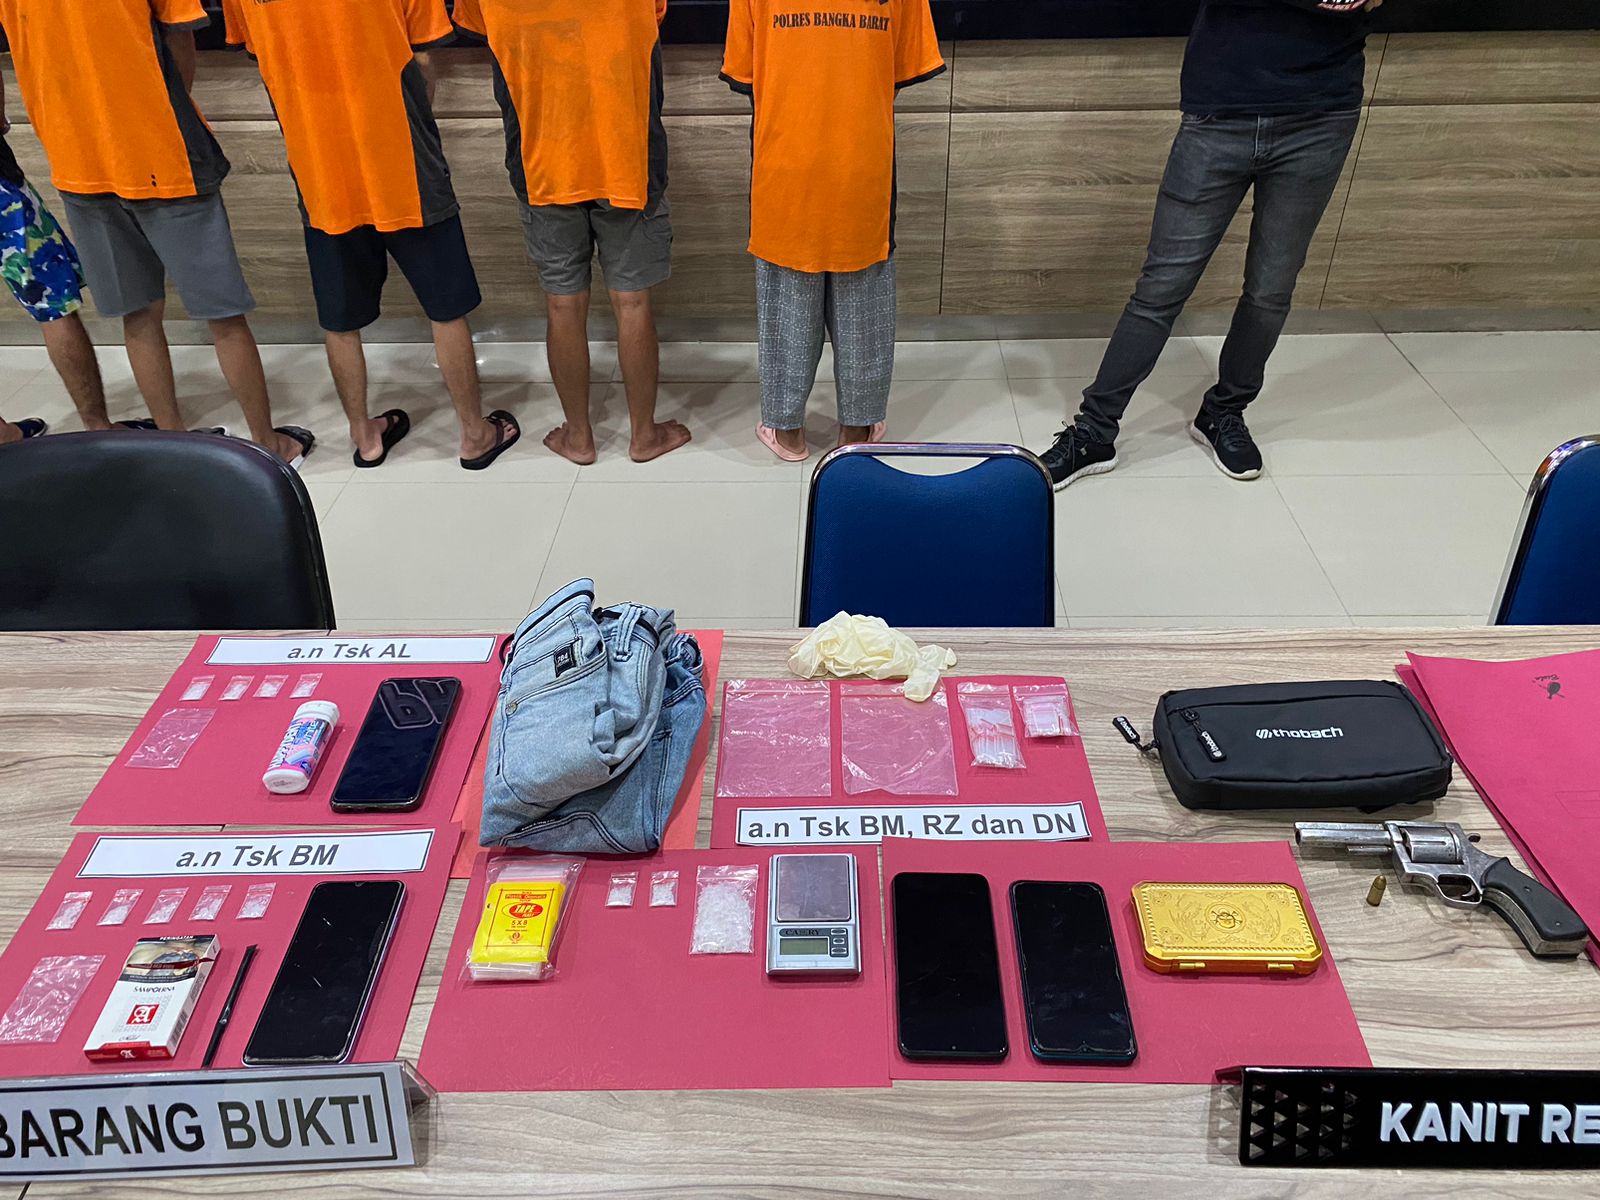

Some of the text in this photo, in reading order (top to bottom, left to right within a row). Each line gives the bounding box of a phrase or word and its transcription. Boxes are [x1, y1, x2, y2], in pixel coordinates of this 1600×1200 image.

[773, 12, 889, 31] POLRES BANGKA BARAT
[287, 643, 412, 659] a.n Tsk AL
[747, 813, 1076, 839] a.n Tsk BM, RZ dan DN
[175, 844, 340, 868] a.n Tsk BM
[217, 1094, 378, 1150] BUKTI
[1380, 1102, 1530, 1143] KANIT
